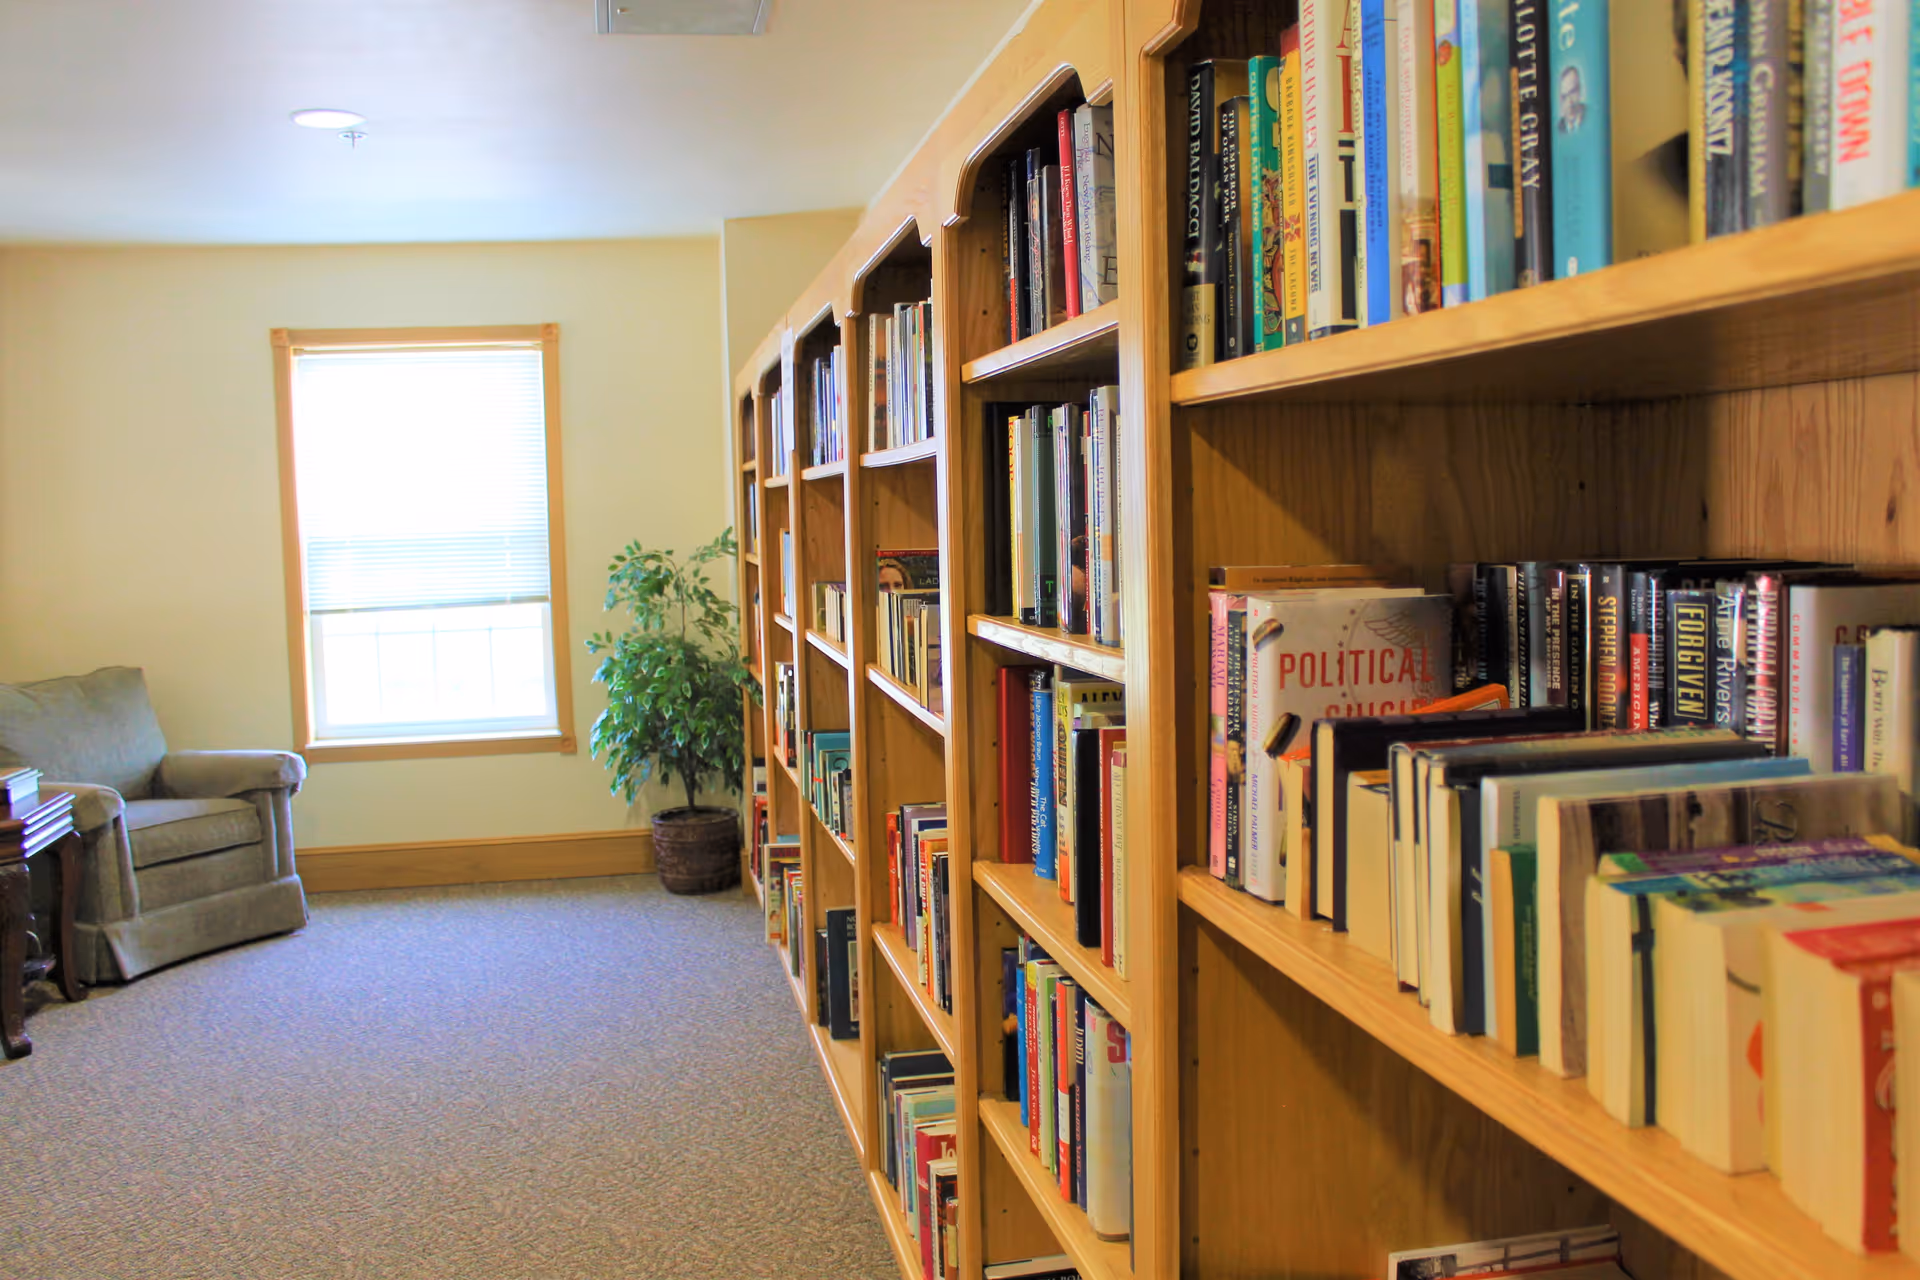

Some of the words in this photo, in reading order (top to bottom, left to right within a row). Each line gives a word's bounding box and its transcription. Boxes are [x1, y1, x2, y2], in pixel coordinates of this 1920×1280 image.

[1515, 0, 1538, 102] LOTTE
[1189, 74, 1200, 134] DAVID
[1221, 113, 1228, 128] OF
[1749, 62, 1775, 198] GRISHAM
[1837, 61, 1872, 165] DOWN
[1228, 144, 1237, 210] EMPEROR
[1307, 156, 1317, 182] THE
[1519, 113, 1541, 190] GRAY
[1083, 199, 1091, 230] Moon
[1189, 138, 1201, 239] BALDACCI
[1308, 186, 1318, 248] EVENING
[1084, 232, 1092, 263] Rising
[1309, 252, 1319, 294] NEWS
[1517, 571, 1525, 600] THE
[1551, 587, 1560, 600] IN
[1551, 603, 1560, 625] THE
[1570, 583, 1578, 599] IN
[1570, 603, 1579, 629] THE
[1598, 595, 1617, 667] STEPHEN
[1279, 646, 1435, 690] POLITICAL
[1551, 629, 1561, 690] PRESENCE
[1677, 606, 1706, 714] FORGIVEN
[1598, 672, 1616, 727] COONT
[1716, 656, 1737, 724] Rivers
[1746, 685, 1777, 752] CORN
[1871, 668, 1889, 712] Born
[1058, 724, 1068, 808] QUEEN
